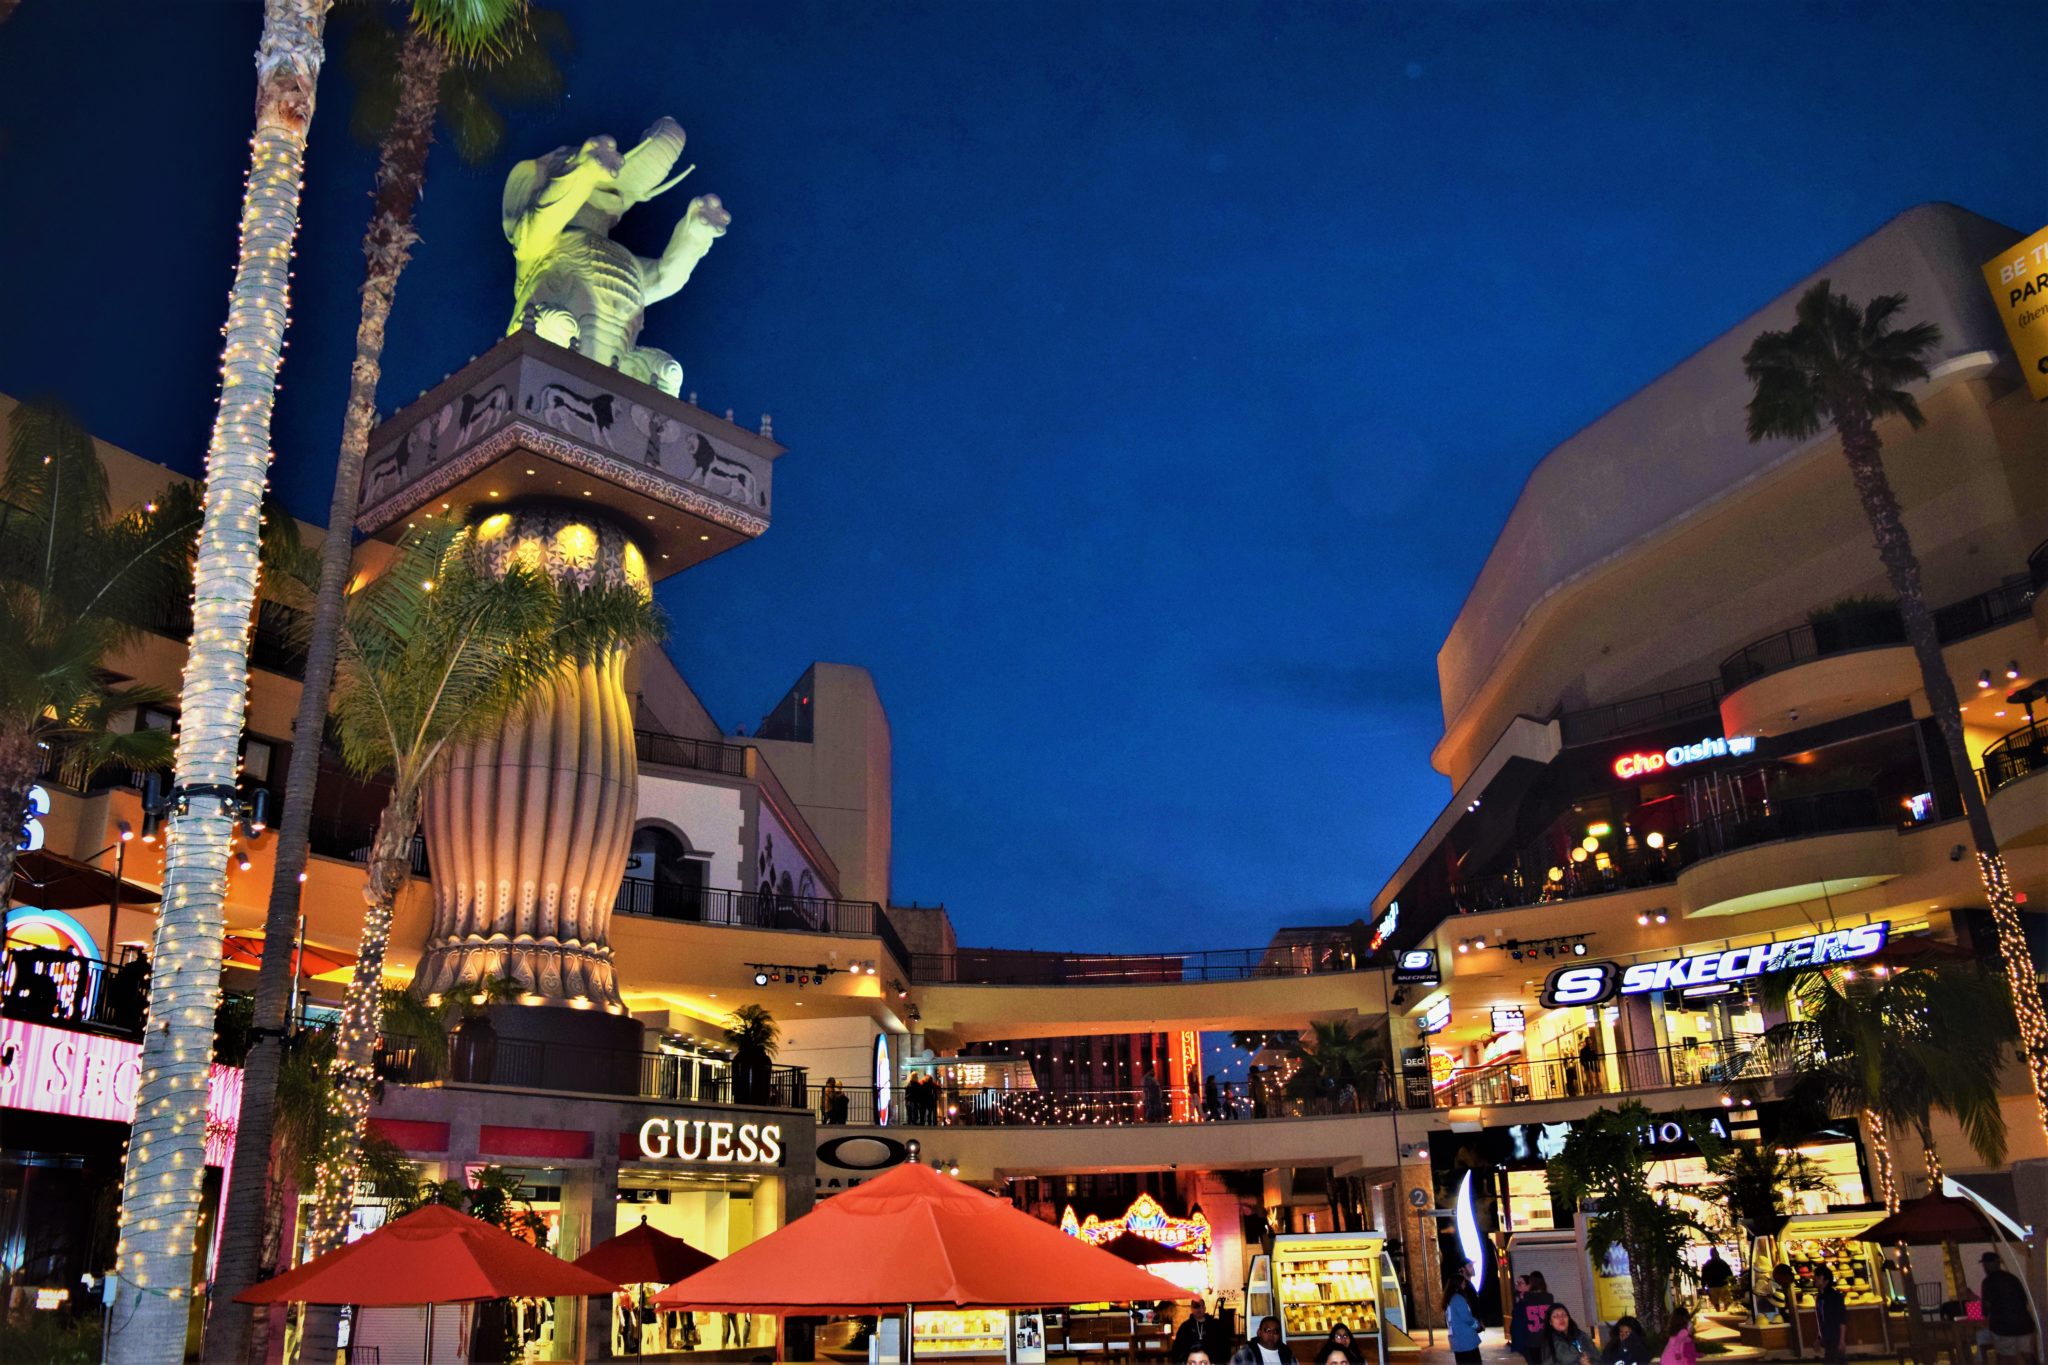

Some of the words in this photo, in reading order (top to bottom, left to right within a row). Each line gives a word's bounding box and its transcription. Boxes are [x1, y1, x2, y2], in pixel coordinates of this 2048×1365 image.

[2001, 256, 2027, 286] BE
[2010, 272, 2048, 308] PAR
[1614, 752, 1664, 778] Cho
[1665, 737, 1727, 767] Oishi
[1620, 921, 1886, 995] SKECHERS
[1418, 1017, 1427, 1028] 3
[639, 1118, 782, 1163] GUESS
[1413, 1190, 1425, 1205] 2
